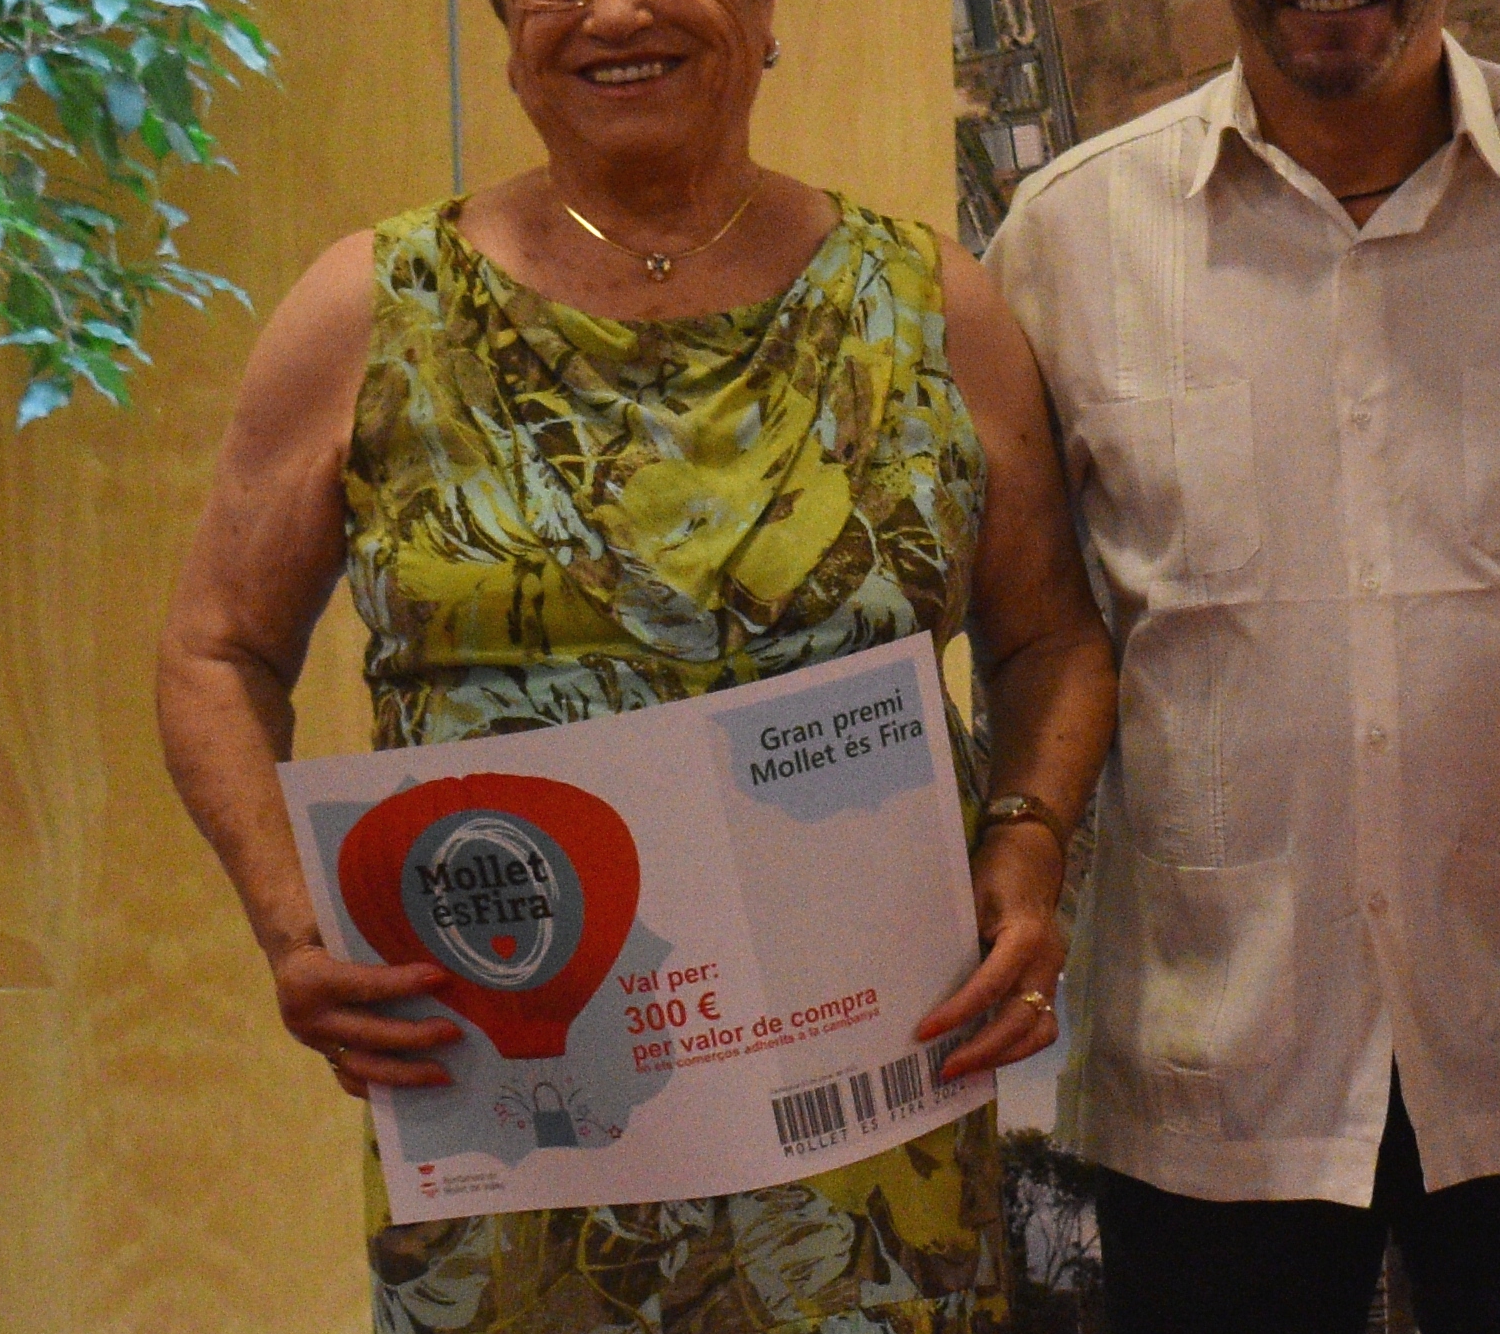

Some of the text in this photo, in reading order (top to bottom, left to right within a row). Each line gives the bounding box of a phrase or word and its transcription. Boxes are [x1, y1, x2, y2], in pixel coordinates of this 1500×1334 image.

[760, 688, 903, 751] Gran premi
[749, 719, 923, 786] Mollet és Fira
[414, 851, 550, 895] Mollet
[617, 963, 720, 995] Val per:
[624, 991, 721, 1035] 300 €
[632, 988, 878, 1065] per valor de compra
[782, 1128, 848, 1158] MOLLET
[890, 1100, 925, 1122] FIRA
